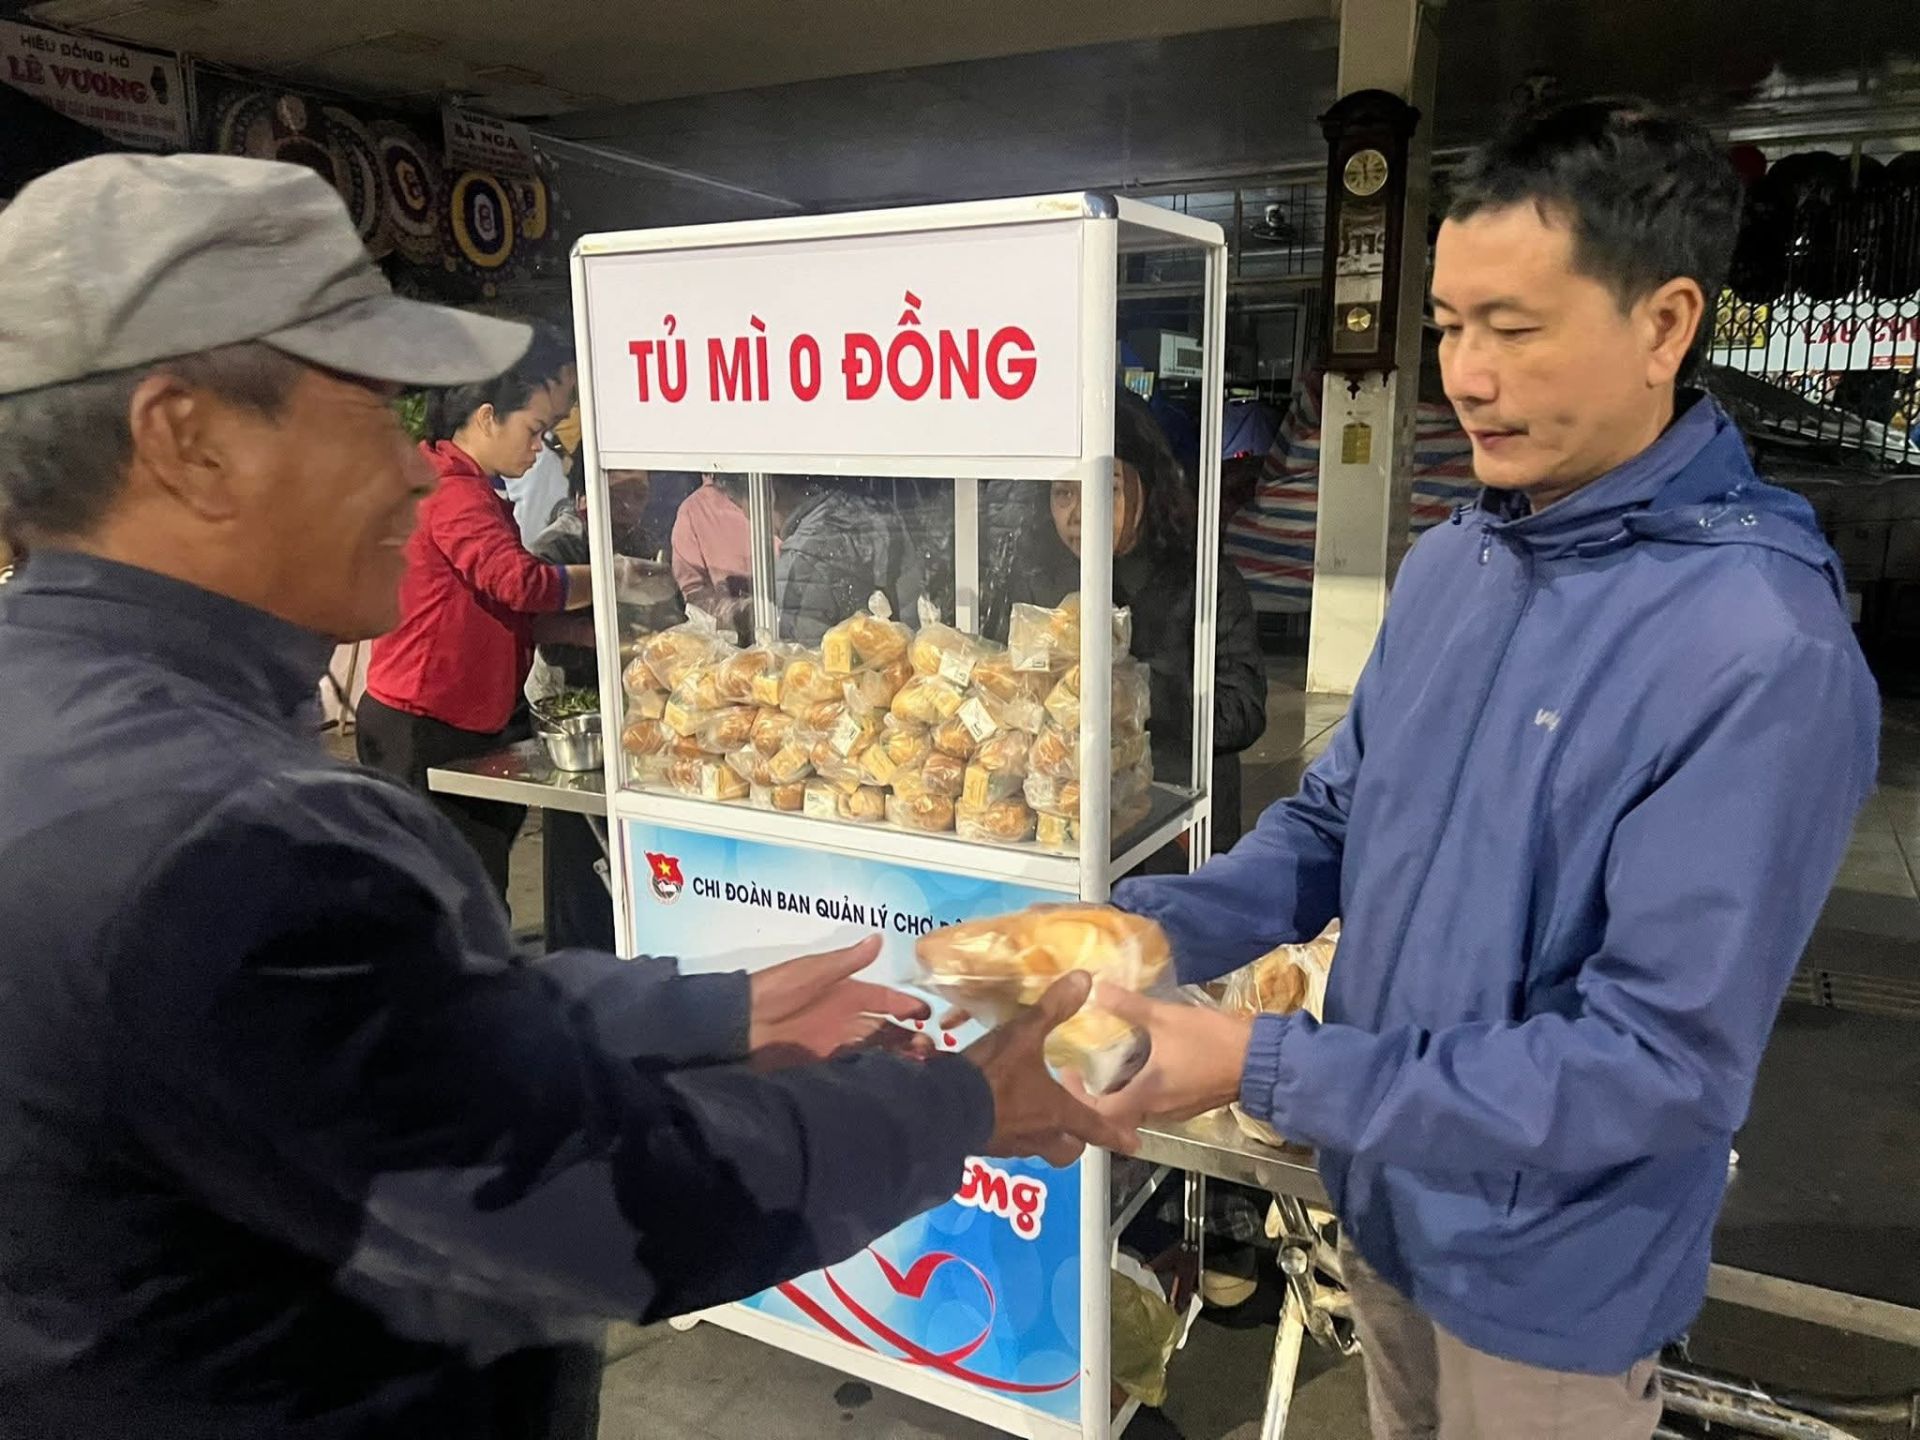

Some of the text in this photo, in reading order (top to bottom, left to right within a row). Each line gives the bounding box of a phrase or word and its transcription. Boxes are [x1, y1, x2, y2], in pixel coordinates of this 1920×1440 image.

[6, 53, 150, 105] LÊ VƯƠNG
[628, 314, 688, 404] TỦ
[707, 314, 769, 402] MÌ
[841, 290, 1038, 402] ĐỒNG
[692, 876, 720, 899] CHI
[725, 881, 773, 909] ĐOÀN
[777, 891, 811, 915] BAN
[815, 895, 865, 925] QUẢN
[870, 904, 888, 929] LÝ
